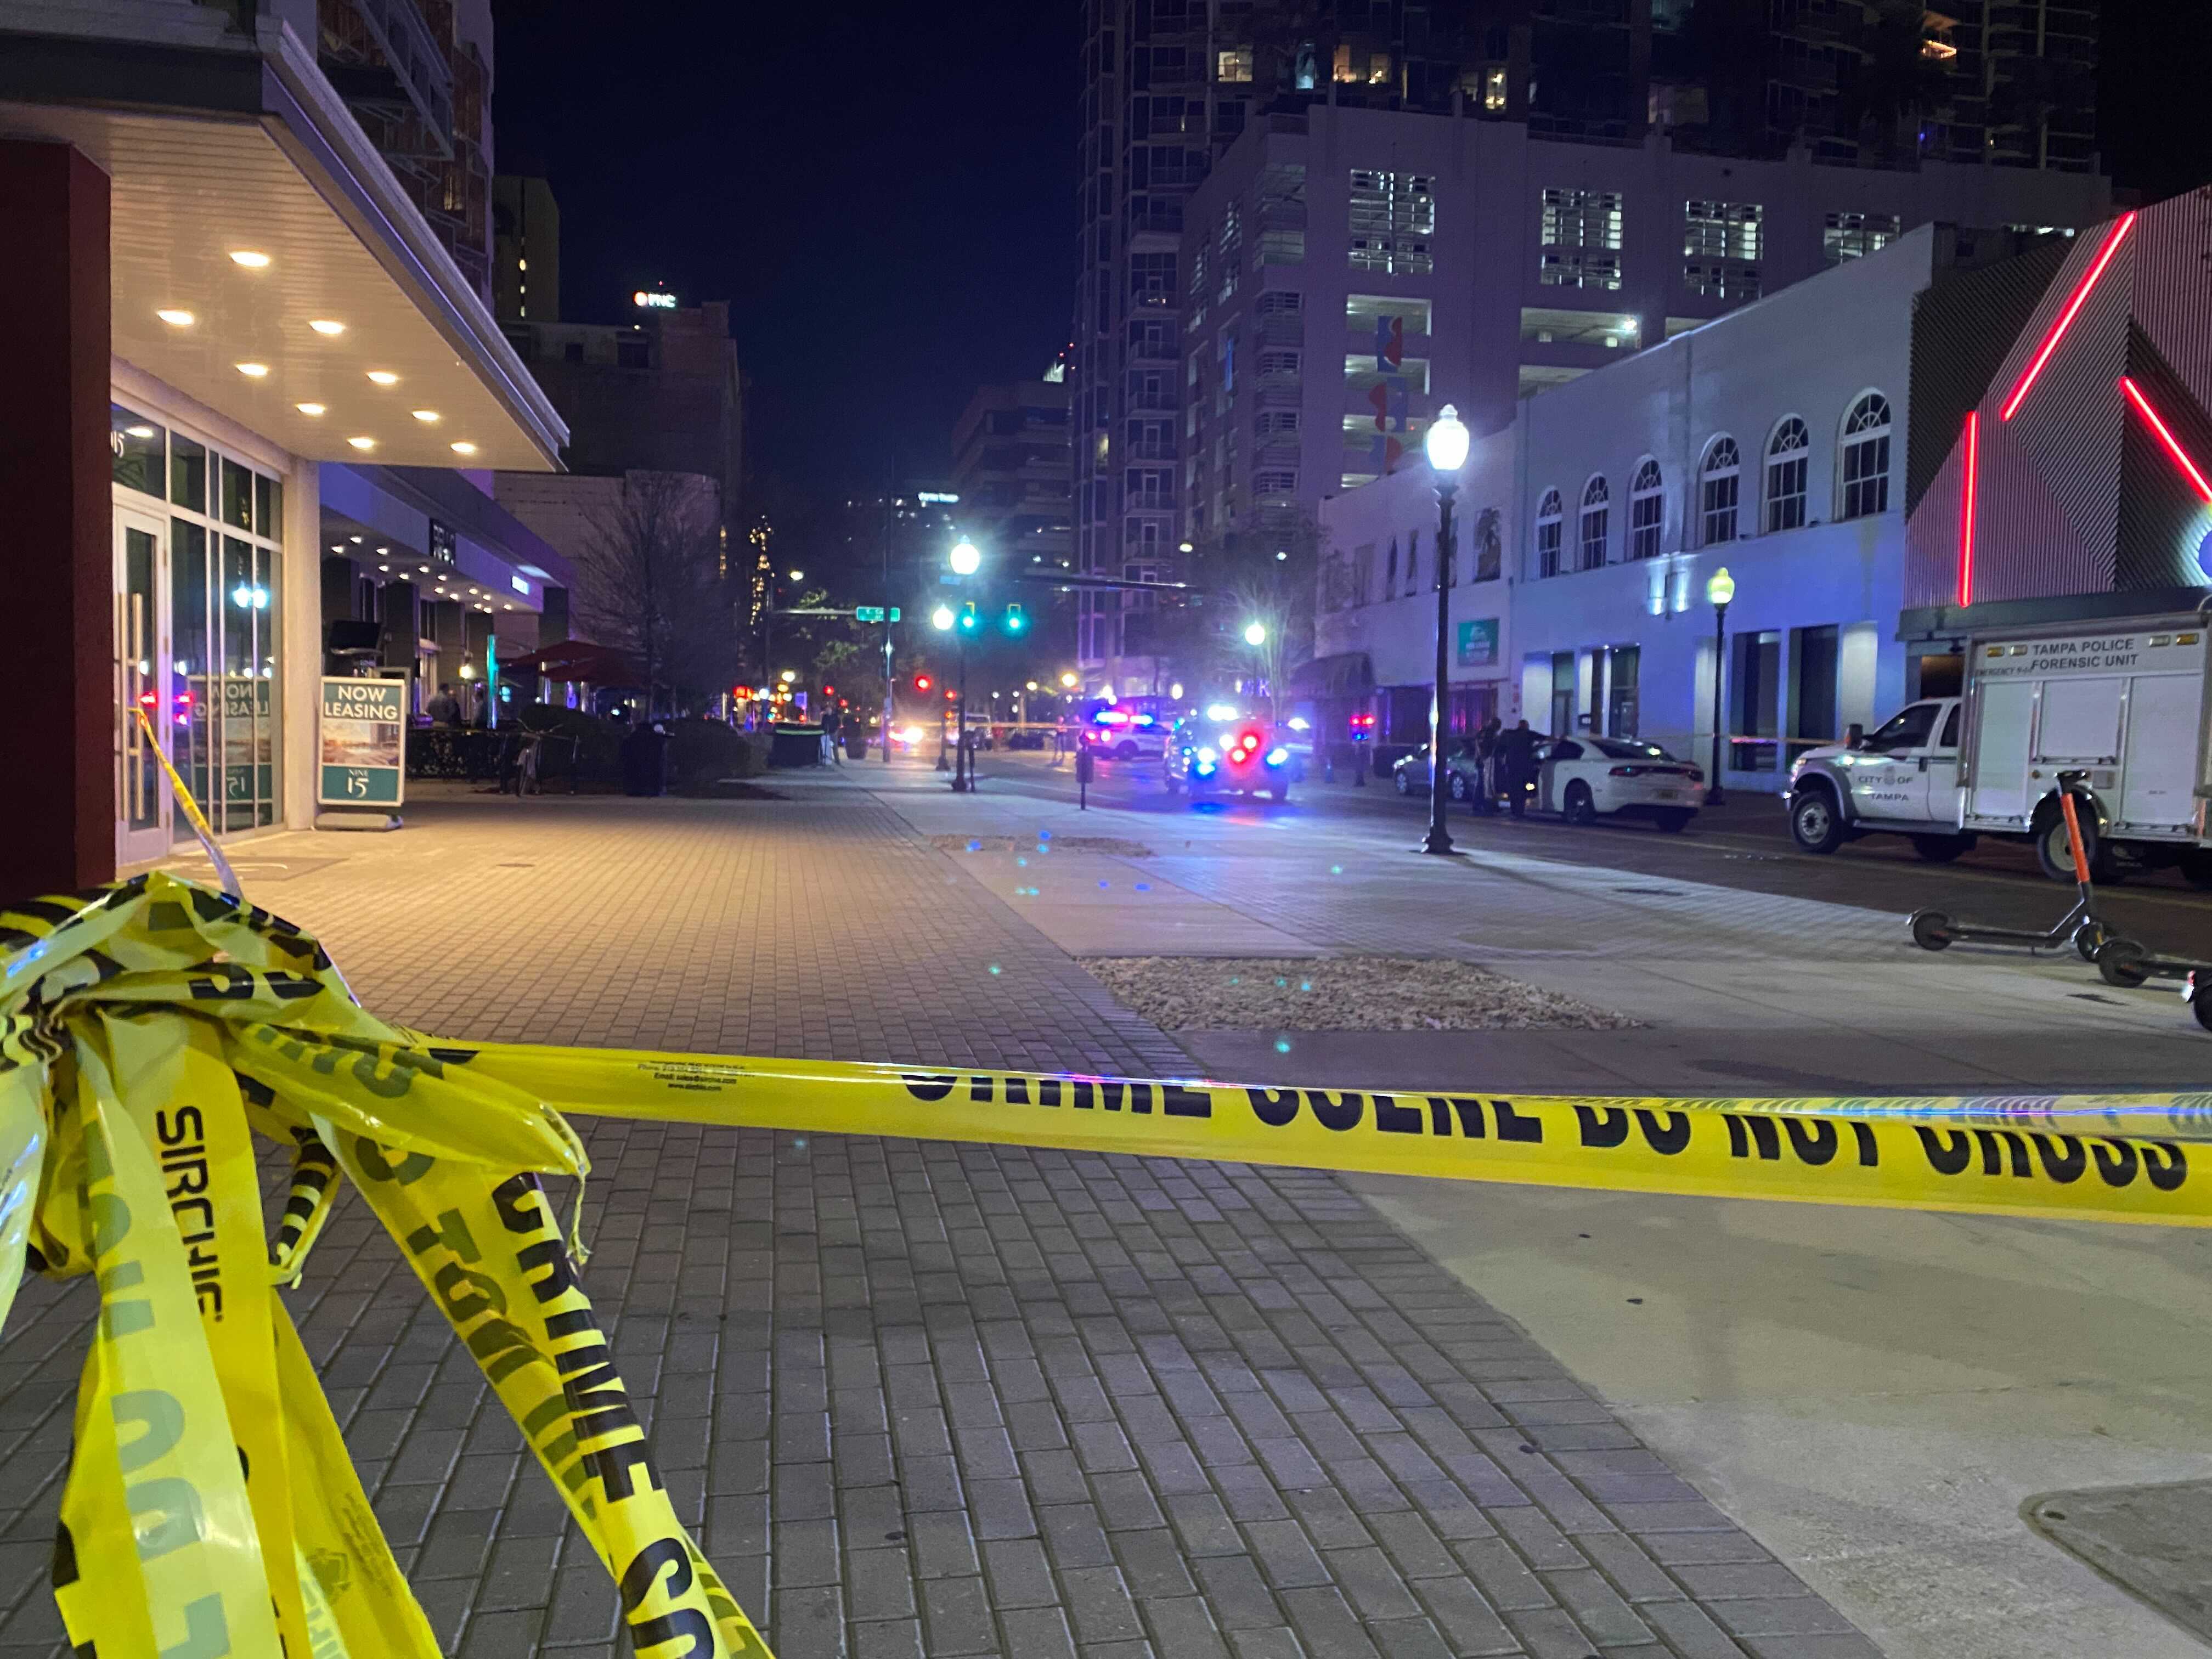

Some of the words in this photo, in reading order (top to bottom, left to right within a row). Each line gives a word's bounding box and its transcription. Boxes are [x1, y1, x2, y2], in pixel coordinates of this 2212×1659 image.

[2033, 642, 2077, 655] TAMPA
[2082, 639, 2135, 652] POLICE
[2030, 656, 2100, 670] FORENSIC
[2104, 653, 2138, 667] UNIT
[338, 685, 386, 702] NOW
[325, 702, 398, 720] LEASING
[348, 777, 369, 798] 15
